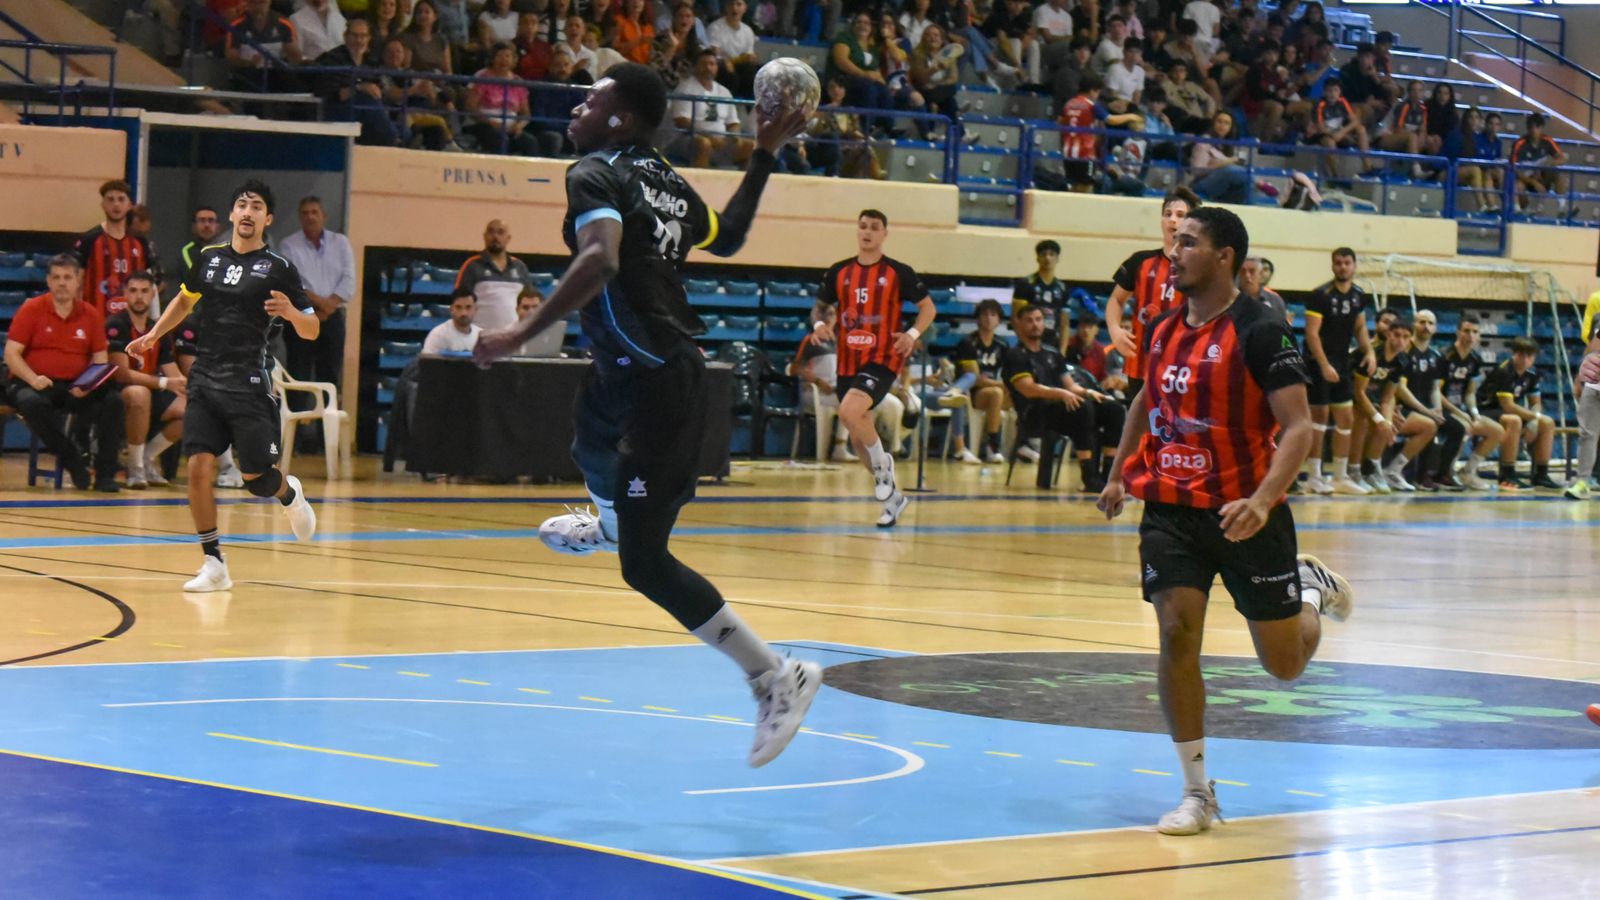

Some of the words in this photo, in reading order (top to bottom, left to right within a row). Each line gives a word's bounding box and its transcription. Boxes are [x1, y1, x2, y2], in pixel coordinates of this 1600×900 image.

[443, 167, 506, 186] PRENSA
[113, 258, 128, 273] 90
[223, 264, 244, 285] 99
[854, 287, 869, 304] 15
[1160, 283, 1175, 302] 14
[1161, 365, 1192, 394] 58
